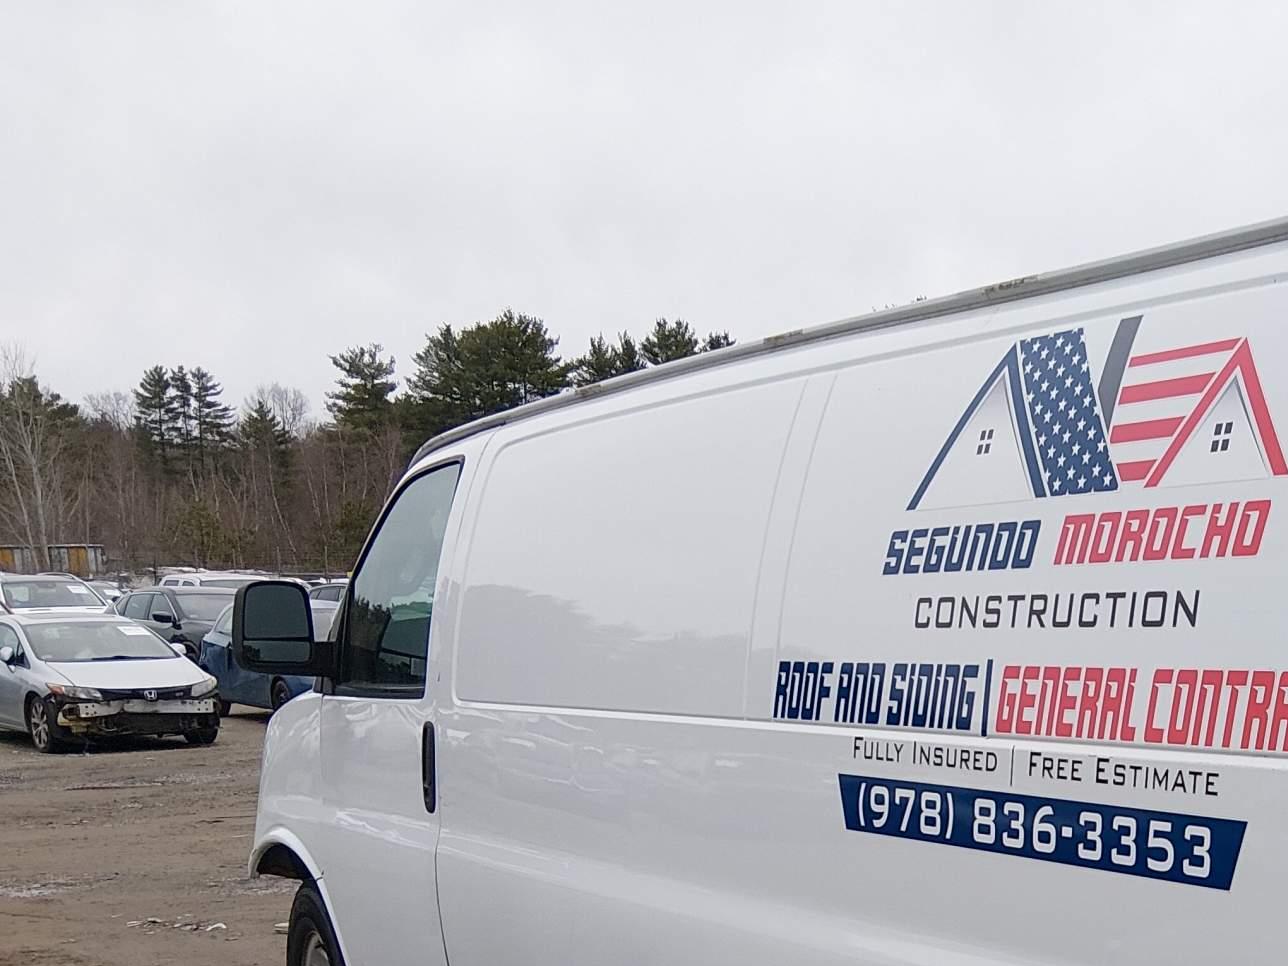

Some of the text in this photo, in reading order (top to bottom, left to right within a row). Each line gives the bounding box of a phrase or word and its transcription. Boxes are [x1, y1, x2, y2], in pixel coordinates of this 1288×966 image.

[882, 499, 1272, 575] SEGUNDO MOROCHO
[914, 590, 1201, 629] CONSTRUCTION
[773, 660, 834, 721] ROOF
[834, 660, 887, 726] AND
[885, 662, 980, 731] SIDING
[995, 664, 1138, 742] GENERAL
[857, 780, 1213, 879] (978) 836-3353
